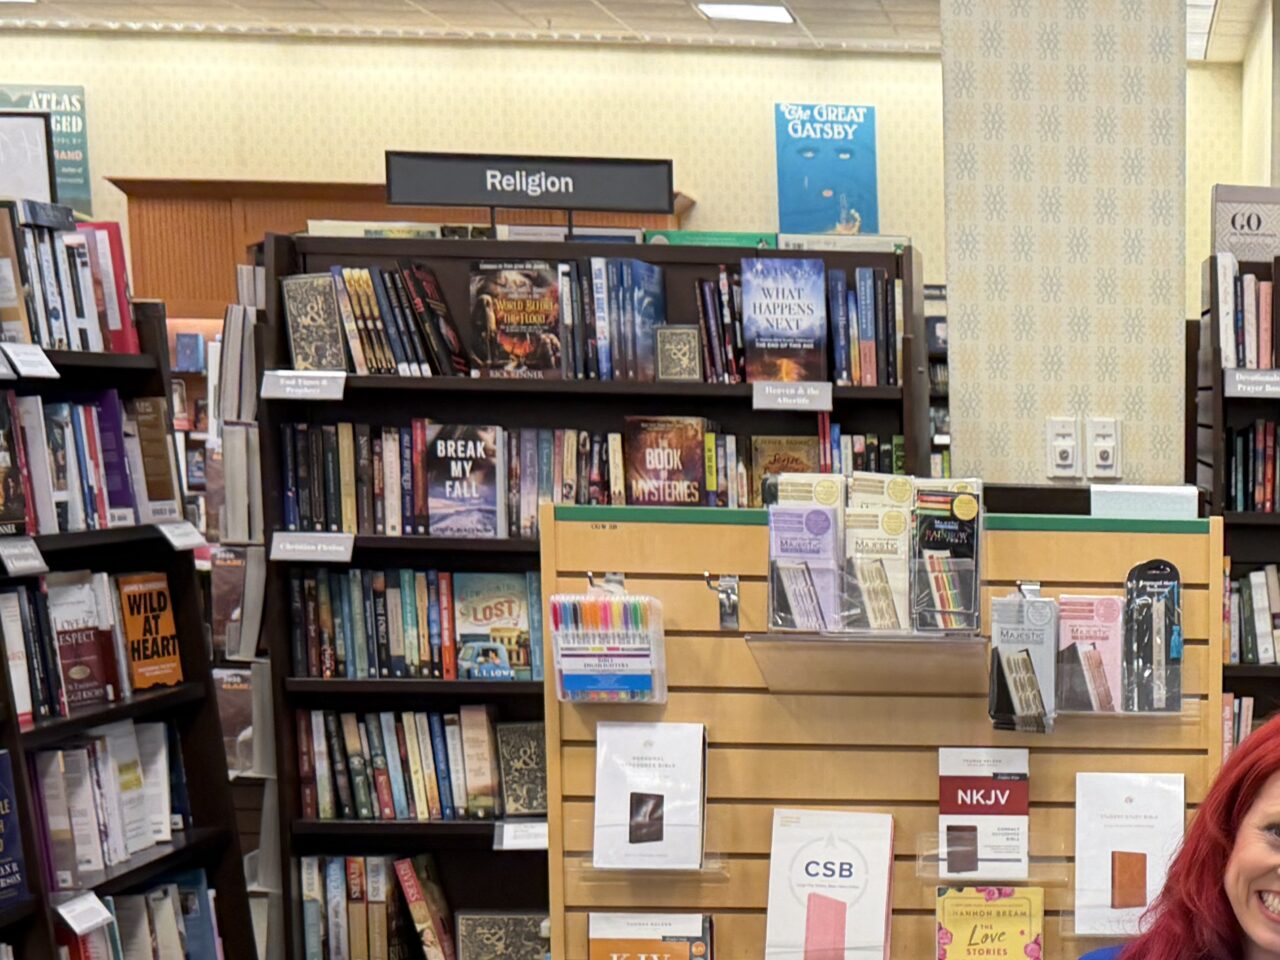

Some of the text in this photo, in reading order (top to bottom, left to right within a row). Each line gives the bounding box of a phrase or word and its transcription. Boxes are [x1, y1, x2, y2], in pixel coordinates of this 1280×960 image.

[28, 92, 82, 111] ATLAS
[780, 103, 867, 123] The GREAT
[788, 121, 857, 140] GATSBY
[486, 169, 574, 195] Religion
[1231, 212, 1262, 232] GO
[761, 287, 805, 300] WHAT
[753, 302, 815, 316] HAPPENS
[765, 318, 802, 331] NEXT
[1235, 372, 1280, 382] Devotionals
[765, 386, 796, 395] Heaven
[1237, 383, 1264, 393] Prayer
[437, 439, 486, 459] BREAK
[645, 447, 683, 470] BOOK
[450, 460, 473, 477] MY
[445, 481, 480, 498] FALL
[632, 480, 699, 502] MYSTERIES
[128, 591, 168, 616] WILD
[471, 600, 515, 622] LOST
[142, 614, 161, 637] AT
[58, 630, 96, 646] ESPECT
[131, 634, 178, 661] HEART
[957, 788, 1010, 805] NKJV
[804, 860, 854, 878] CSB
[351, 863, 360, 898] RIVERS
[399, 862, 420, 902] RIVERS
[968, 924, 1007, 946] Love
